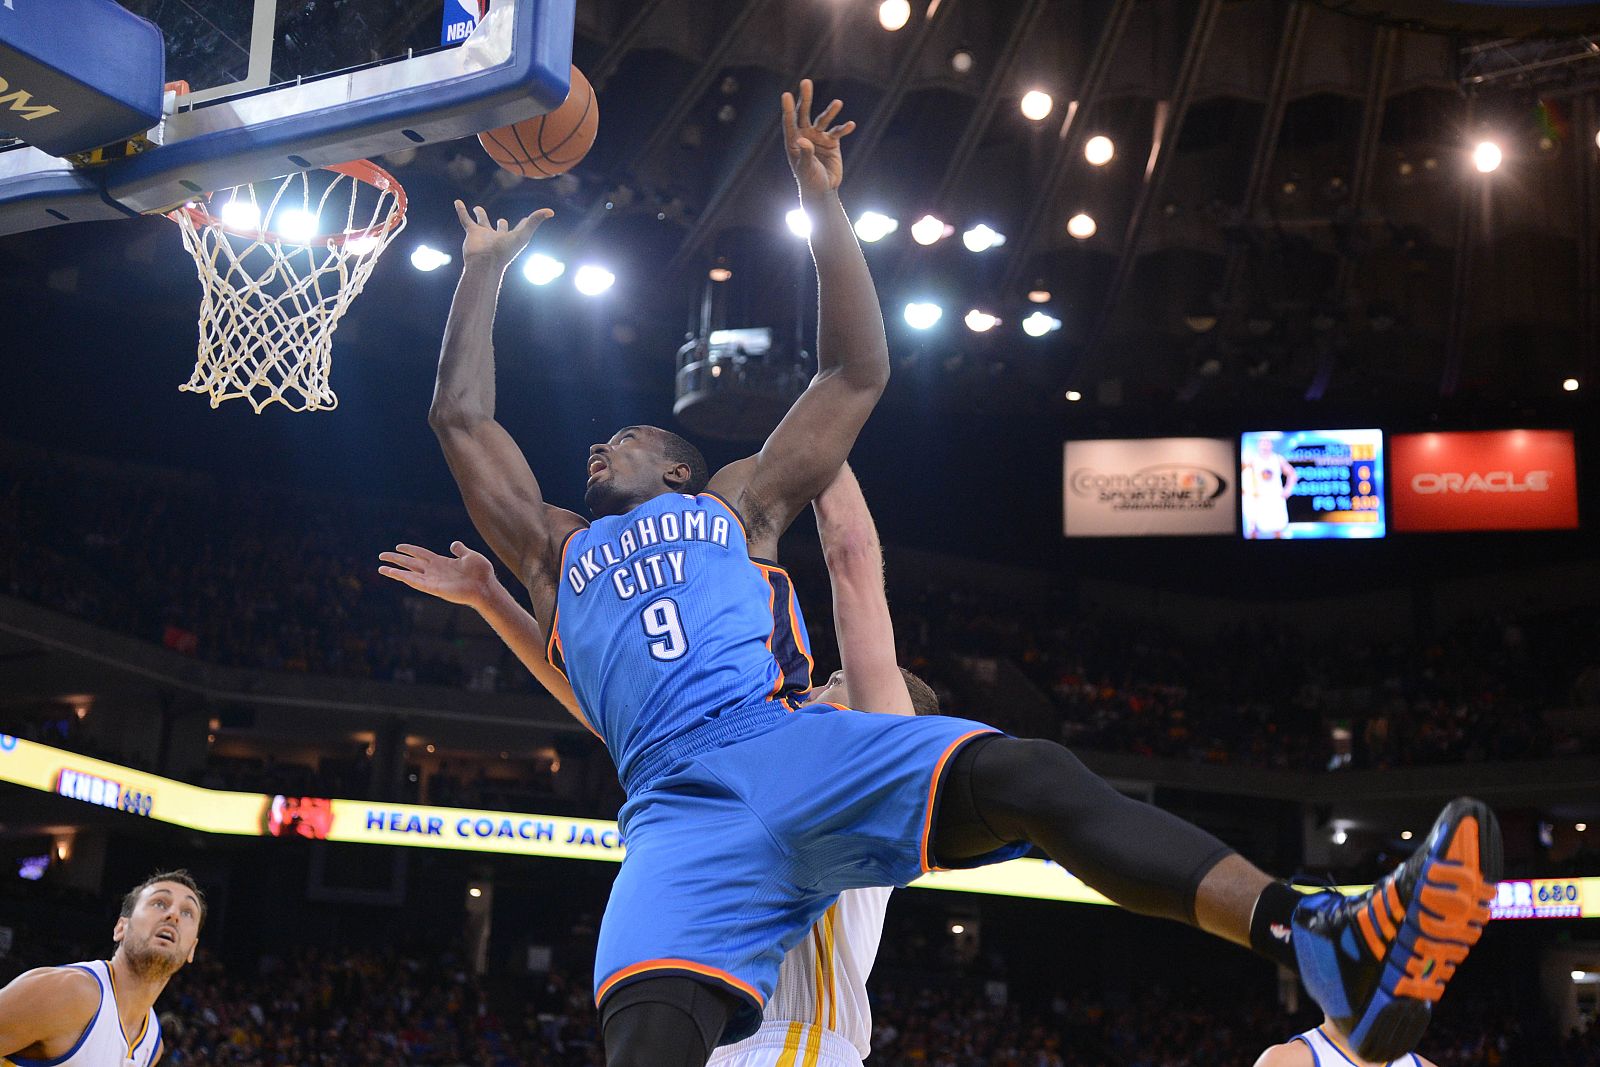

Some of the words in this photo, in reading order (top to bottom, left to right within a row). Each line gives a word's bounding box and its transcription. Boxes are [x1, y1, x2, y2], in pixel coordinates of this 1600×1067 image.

[446, 20, 475, 42] NBA
[1411, 470, 1551, 494] ORACLE
[568, 509, 731, 596] OKLAHOMA
[611, 550, 687, 601] CITY
[640, 596, 689, 663] 9
[366, 809, 444, 836] HEAR
[456, 817, 554, 842] COACH
[1538, 885, 1577, 902] 680
